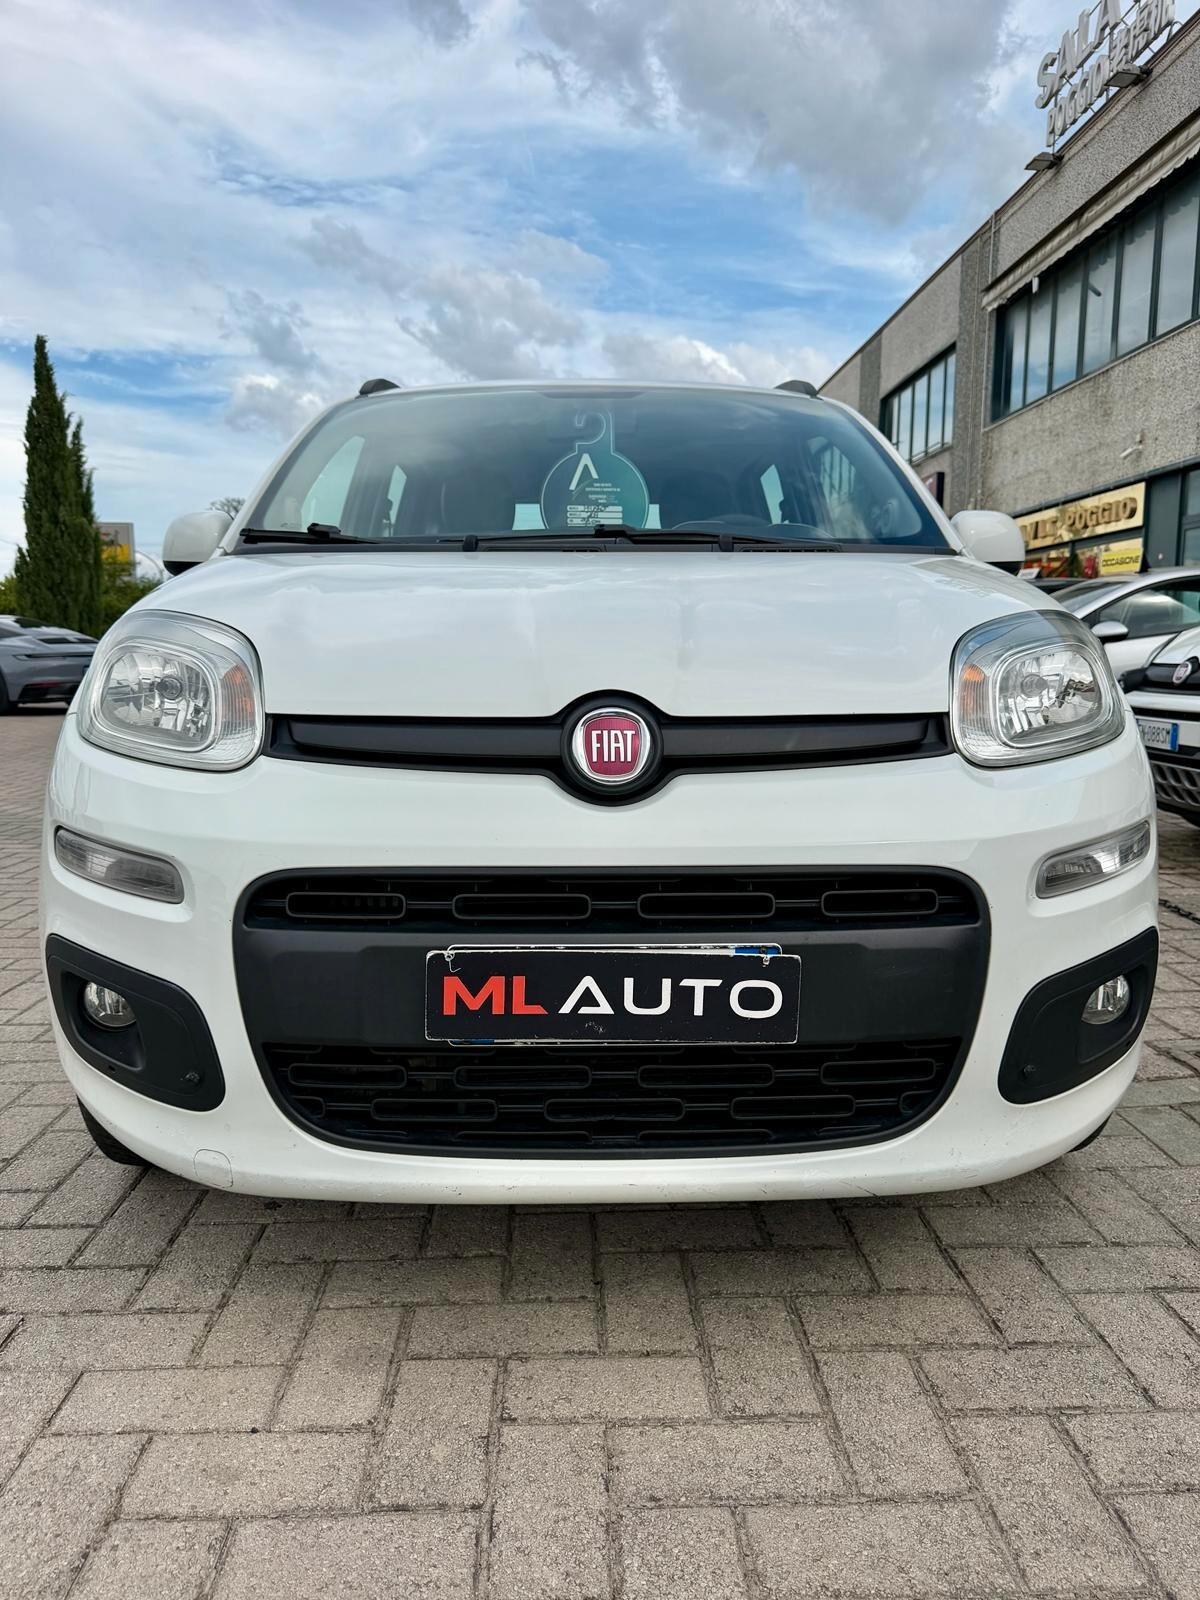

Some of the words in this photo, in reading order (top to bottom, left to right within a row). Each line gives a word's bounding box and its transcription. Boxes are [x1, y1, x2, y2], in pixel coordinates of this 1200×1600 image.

[1035, 0, 1120, 109] SALA
[1046, 55, 1110, 147] POGGIO
[1064, 498, 1137, 528] POGGIO
[591, 730, 636, 762] FIAT
[443, 975, 549, 1016] ML
[558, 975, 783, 1019] AUTO
